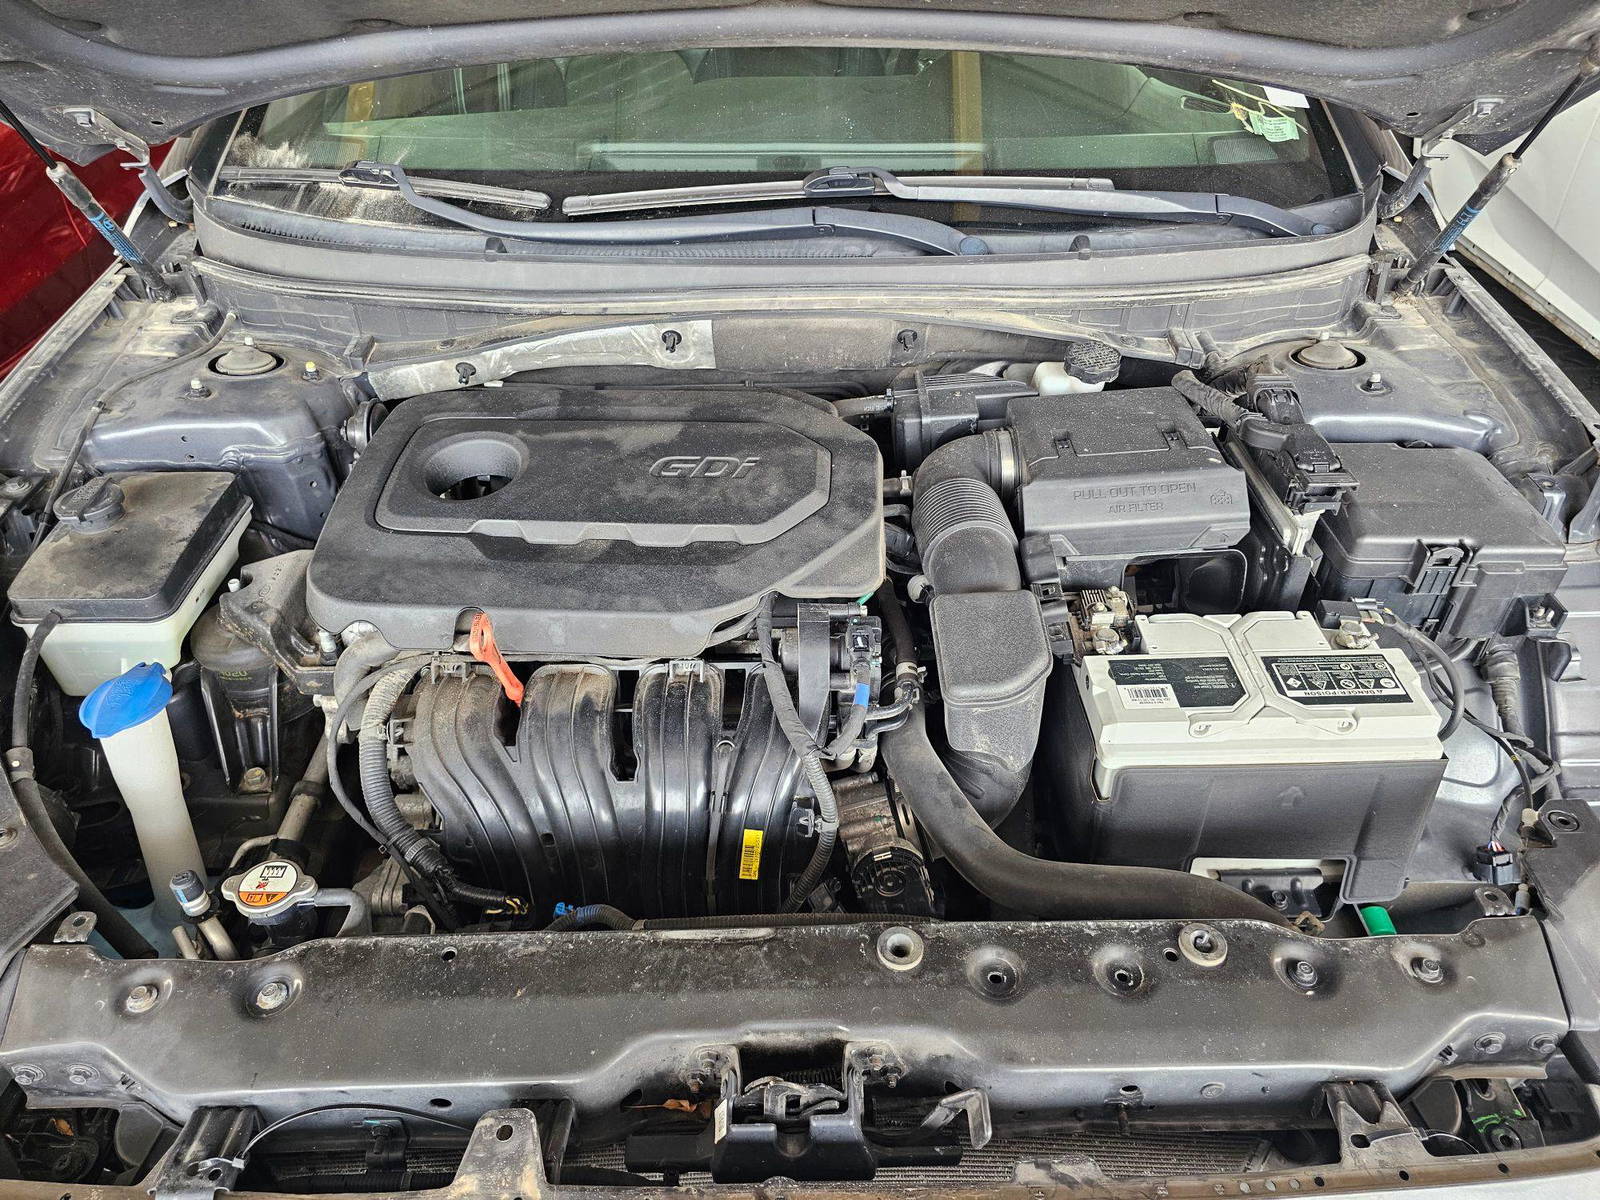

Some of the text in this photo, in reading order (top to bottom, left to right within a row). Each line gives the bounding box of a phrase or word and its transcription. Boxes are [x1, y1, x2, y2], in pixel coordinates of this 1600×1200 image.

[1073, 482, 1197, 500] PULL OUT TO OPEN
[1108, 501, 1165, 514] AIR FILTER
